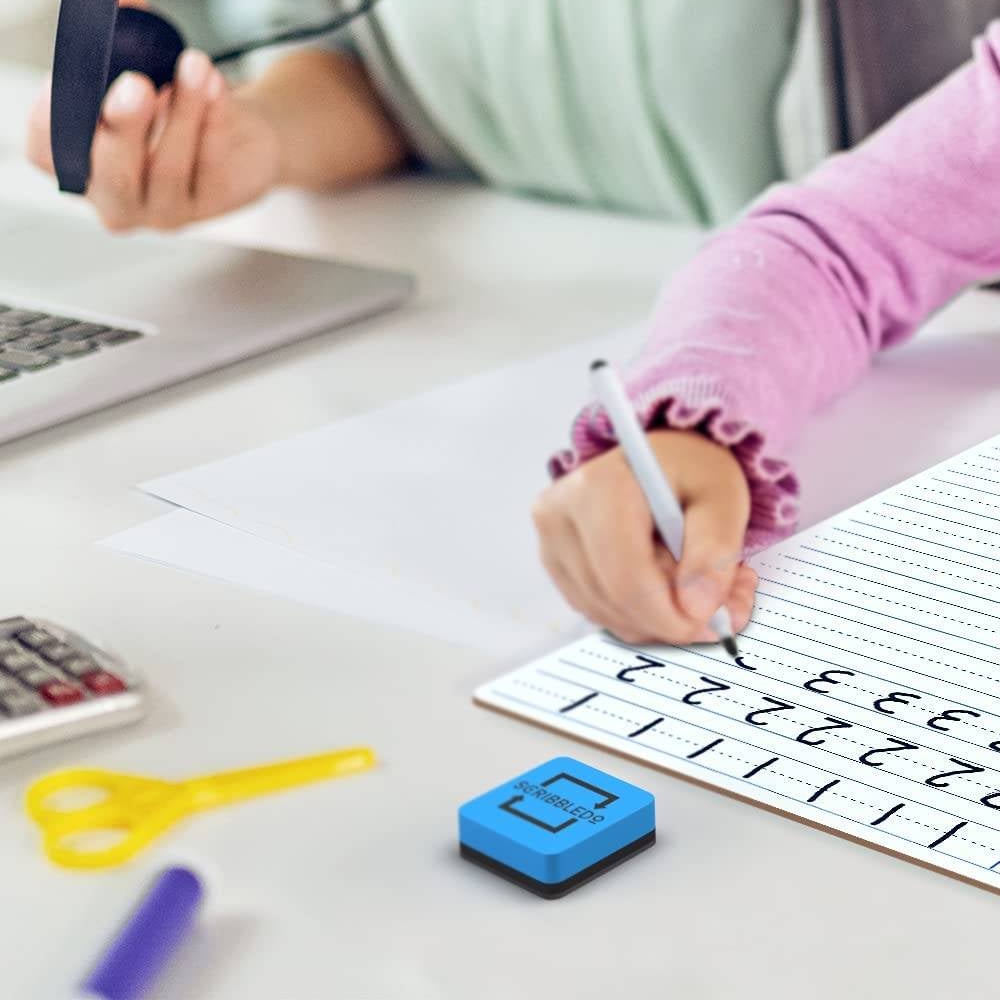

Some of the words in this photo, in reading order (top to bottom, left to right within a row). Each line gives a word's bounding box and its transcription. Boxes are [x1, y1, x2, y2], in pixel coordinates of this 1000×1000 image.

[616, 655, 664, 683] 2
[803, 669, 855, 694] 3
[559, 692, 599, 713] 1
[682, 676, 730, 705] 2
[872, 691, 923, 714] 3
[744, 697, 795, 726] 2
[926, 709, 981, 732] 3
[627, 717, 665, 738] 1
[794, 717, 852, 747] 2
[686, 738, 724, 758] 1
[859, 737, 918, 767] 2
[742, 757, 779, 779] 1
[925, 758, 984, 789] 2
[513, 780, 605, 825] SCRIBBLEDO
[807, 779, 841, 803] 1
[871, 803, 906, 826] 1
[928, 822, 968, 849] 1
